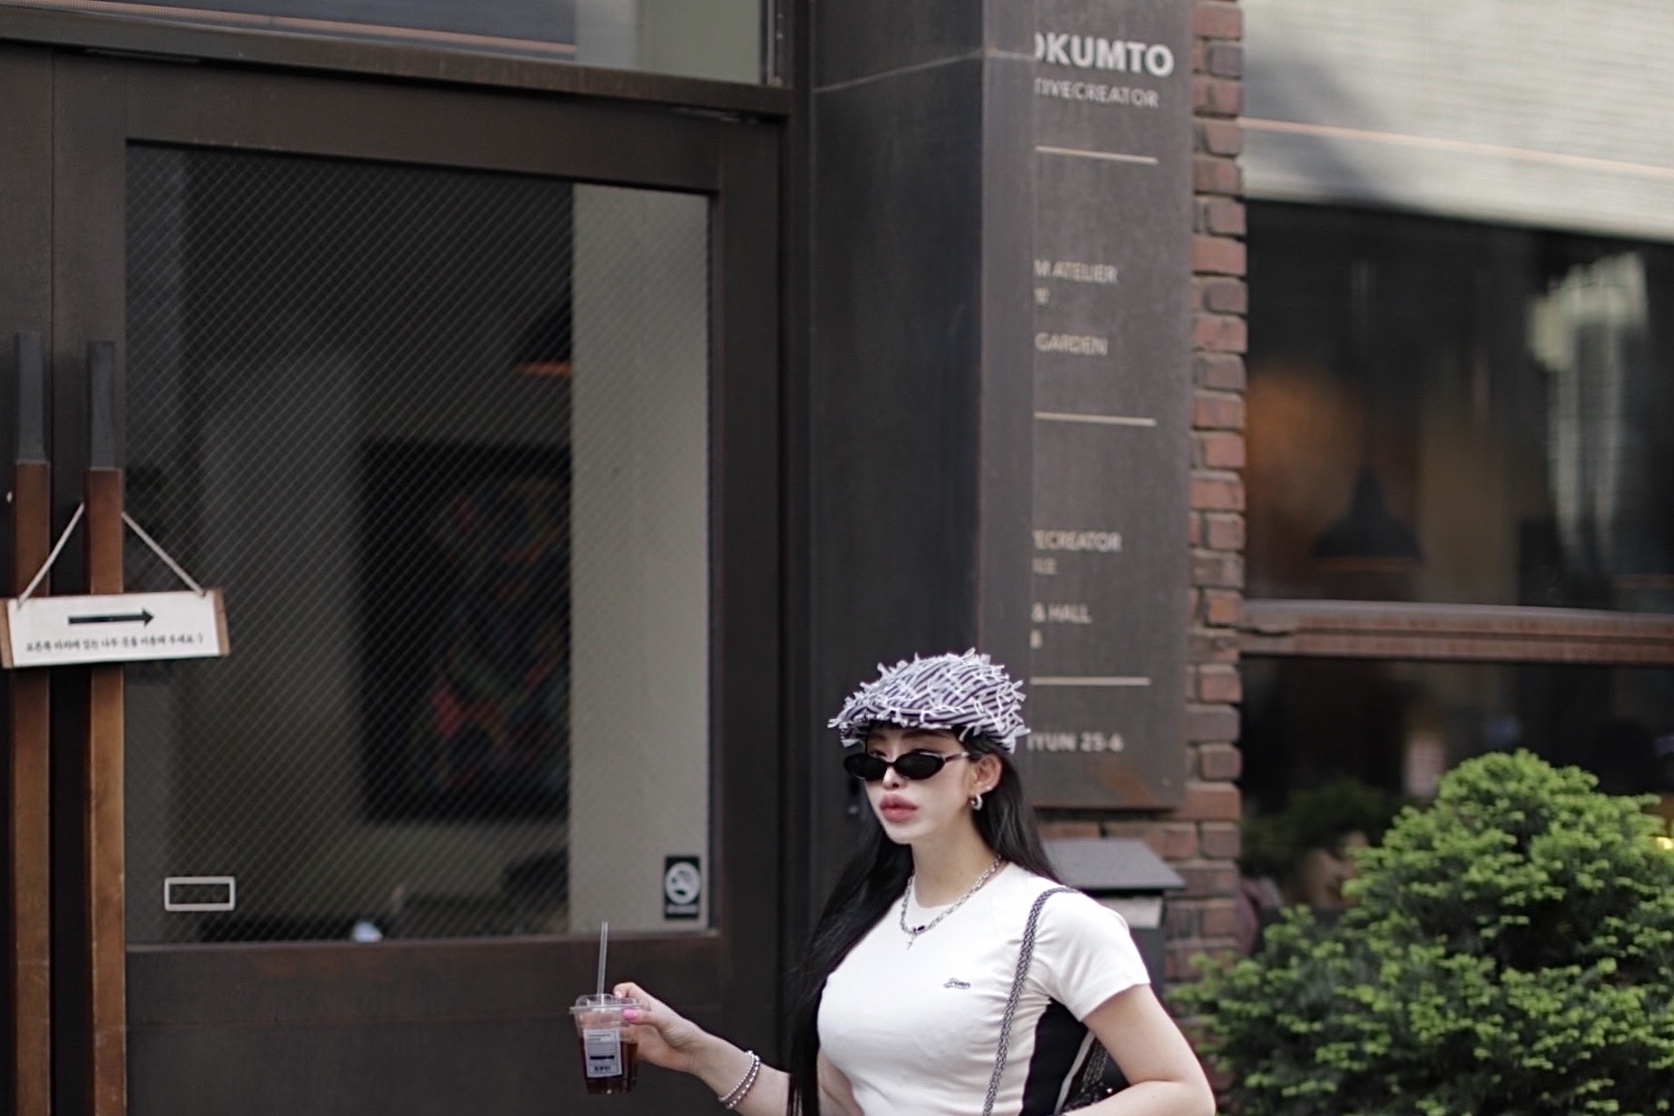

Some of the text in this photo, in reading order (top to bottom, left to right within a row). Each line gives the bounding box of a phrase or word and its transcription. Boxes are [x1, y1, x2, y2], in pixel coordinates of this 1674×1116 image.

[1052, 260, 1118, 284] ATELIER
[1035, 331, 1108, 356] GARDEN
[1048, 603, 1093, 624] HALL
